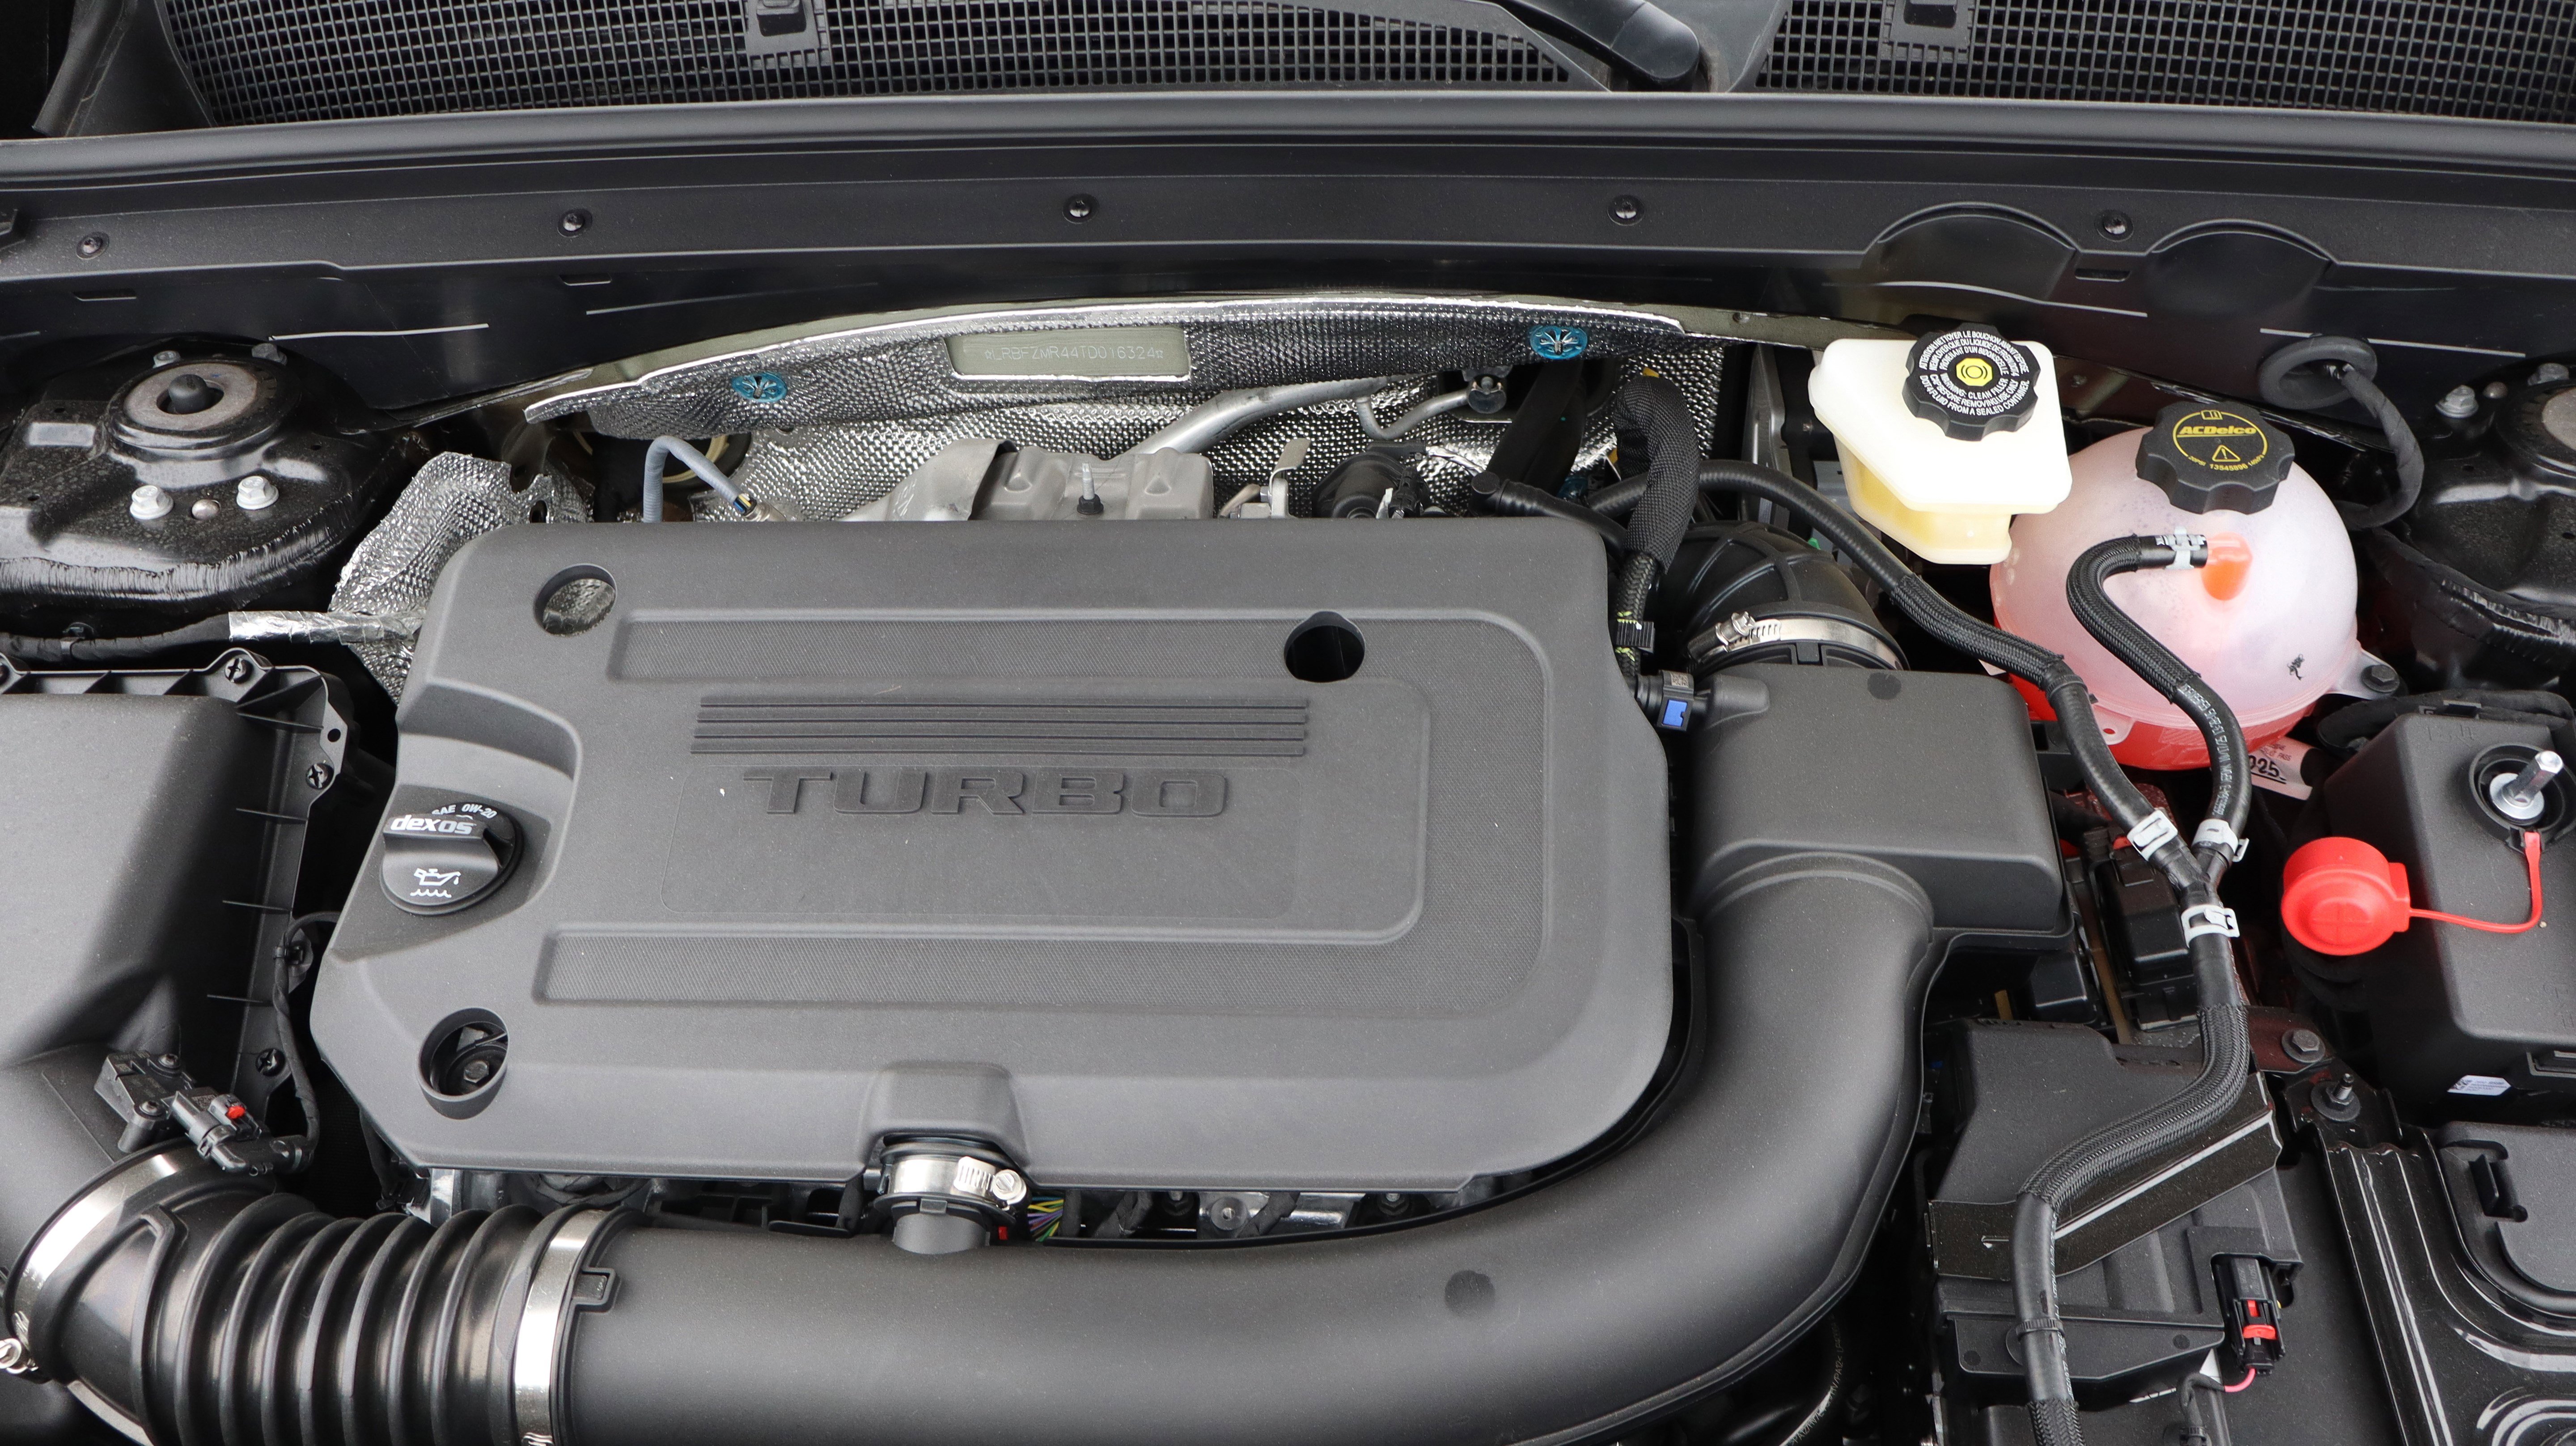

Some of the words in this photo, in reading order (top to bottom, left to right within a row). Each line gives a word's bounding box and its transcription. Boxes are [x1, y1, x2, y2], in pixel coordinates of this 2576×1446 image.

[1946, 339, 1961, 349] QUE
[1969, 339, 1994, 349] LIQUIDE
[1991, 344, 2002, 353] DE
[1972, 331, 2002, 344] BOUCHON
[1999, 340, 2018, 355] AVANT
[1939, 347, 1965, 370] PROVENANT
[1978, 348, 1996, 359] BIDON
[1929, 374, 1942, 387] CAP
[1940, 373, 1967, 398] WARNING:
[1967, 390, 1993, 399] CLEAN
[1990, 377, 2008, 396] FILLER
[2004, 378, 2019, 395] ONLY
[1928, 390, 1949, 406] FLUID
[1946, 401, 1970, 415] FROM
[1976, 404, 2005, 416] SEALED
[1935, 384, 1962, 404] BEFORE
[1995, 391, 2011, 403] USE
[2179, 426, 2257, 435] ACDelco
[743, 770, 1227, 818] TURBO
[432, 805, 456, 815] SAE
[462, 804, 497, 818] 0W-20
[390, 814, 477, 835] dexos
